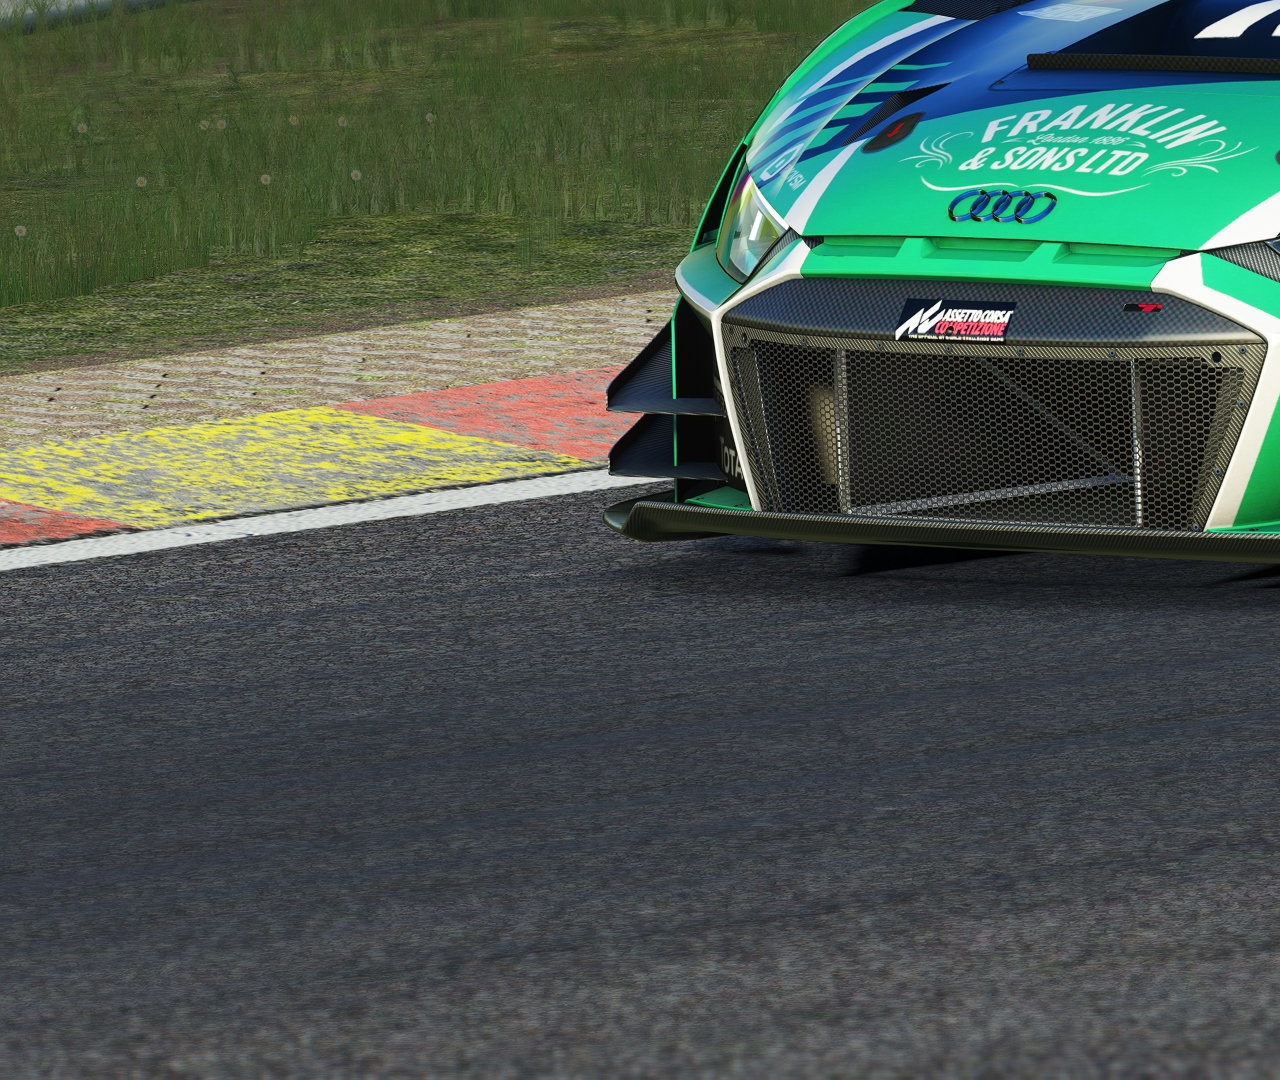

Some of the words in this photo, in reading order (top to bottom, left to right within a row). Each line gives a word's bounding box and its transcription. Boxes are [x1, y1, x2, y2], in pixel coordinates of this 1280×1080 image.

[980, 103, 1228, 149] FRANKLIN
[1027, 133, 1090, 145] London
[958, 147, 996, 171] &
[997, 147, 1090, 171] SONS
[1075, 149, 1149, 176] LTD
[941, 308, 982, 323] ASSETTO
[979, 310, 1014, 324] CORSA
